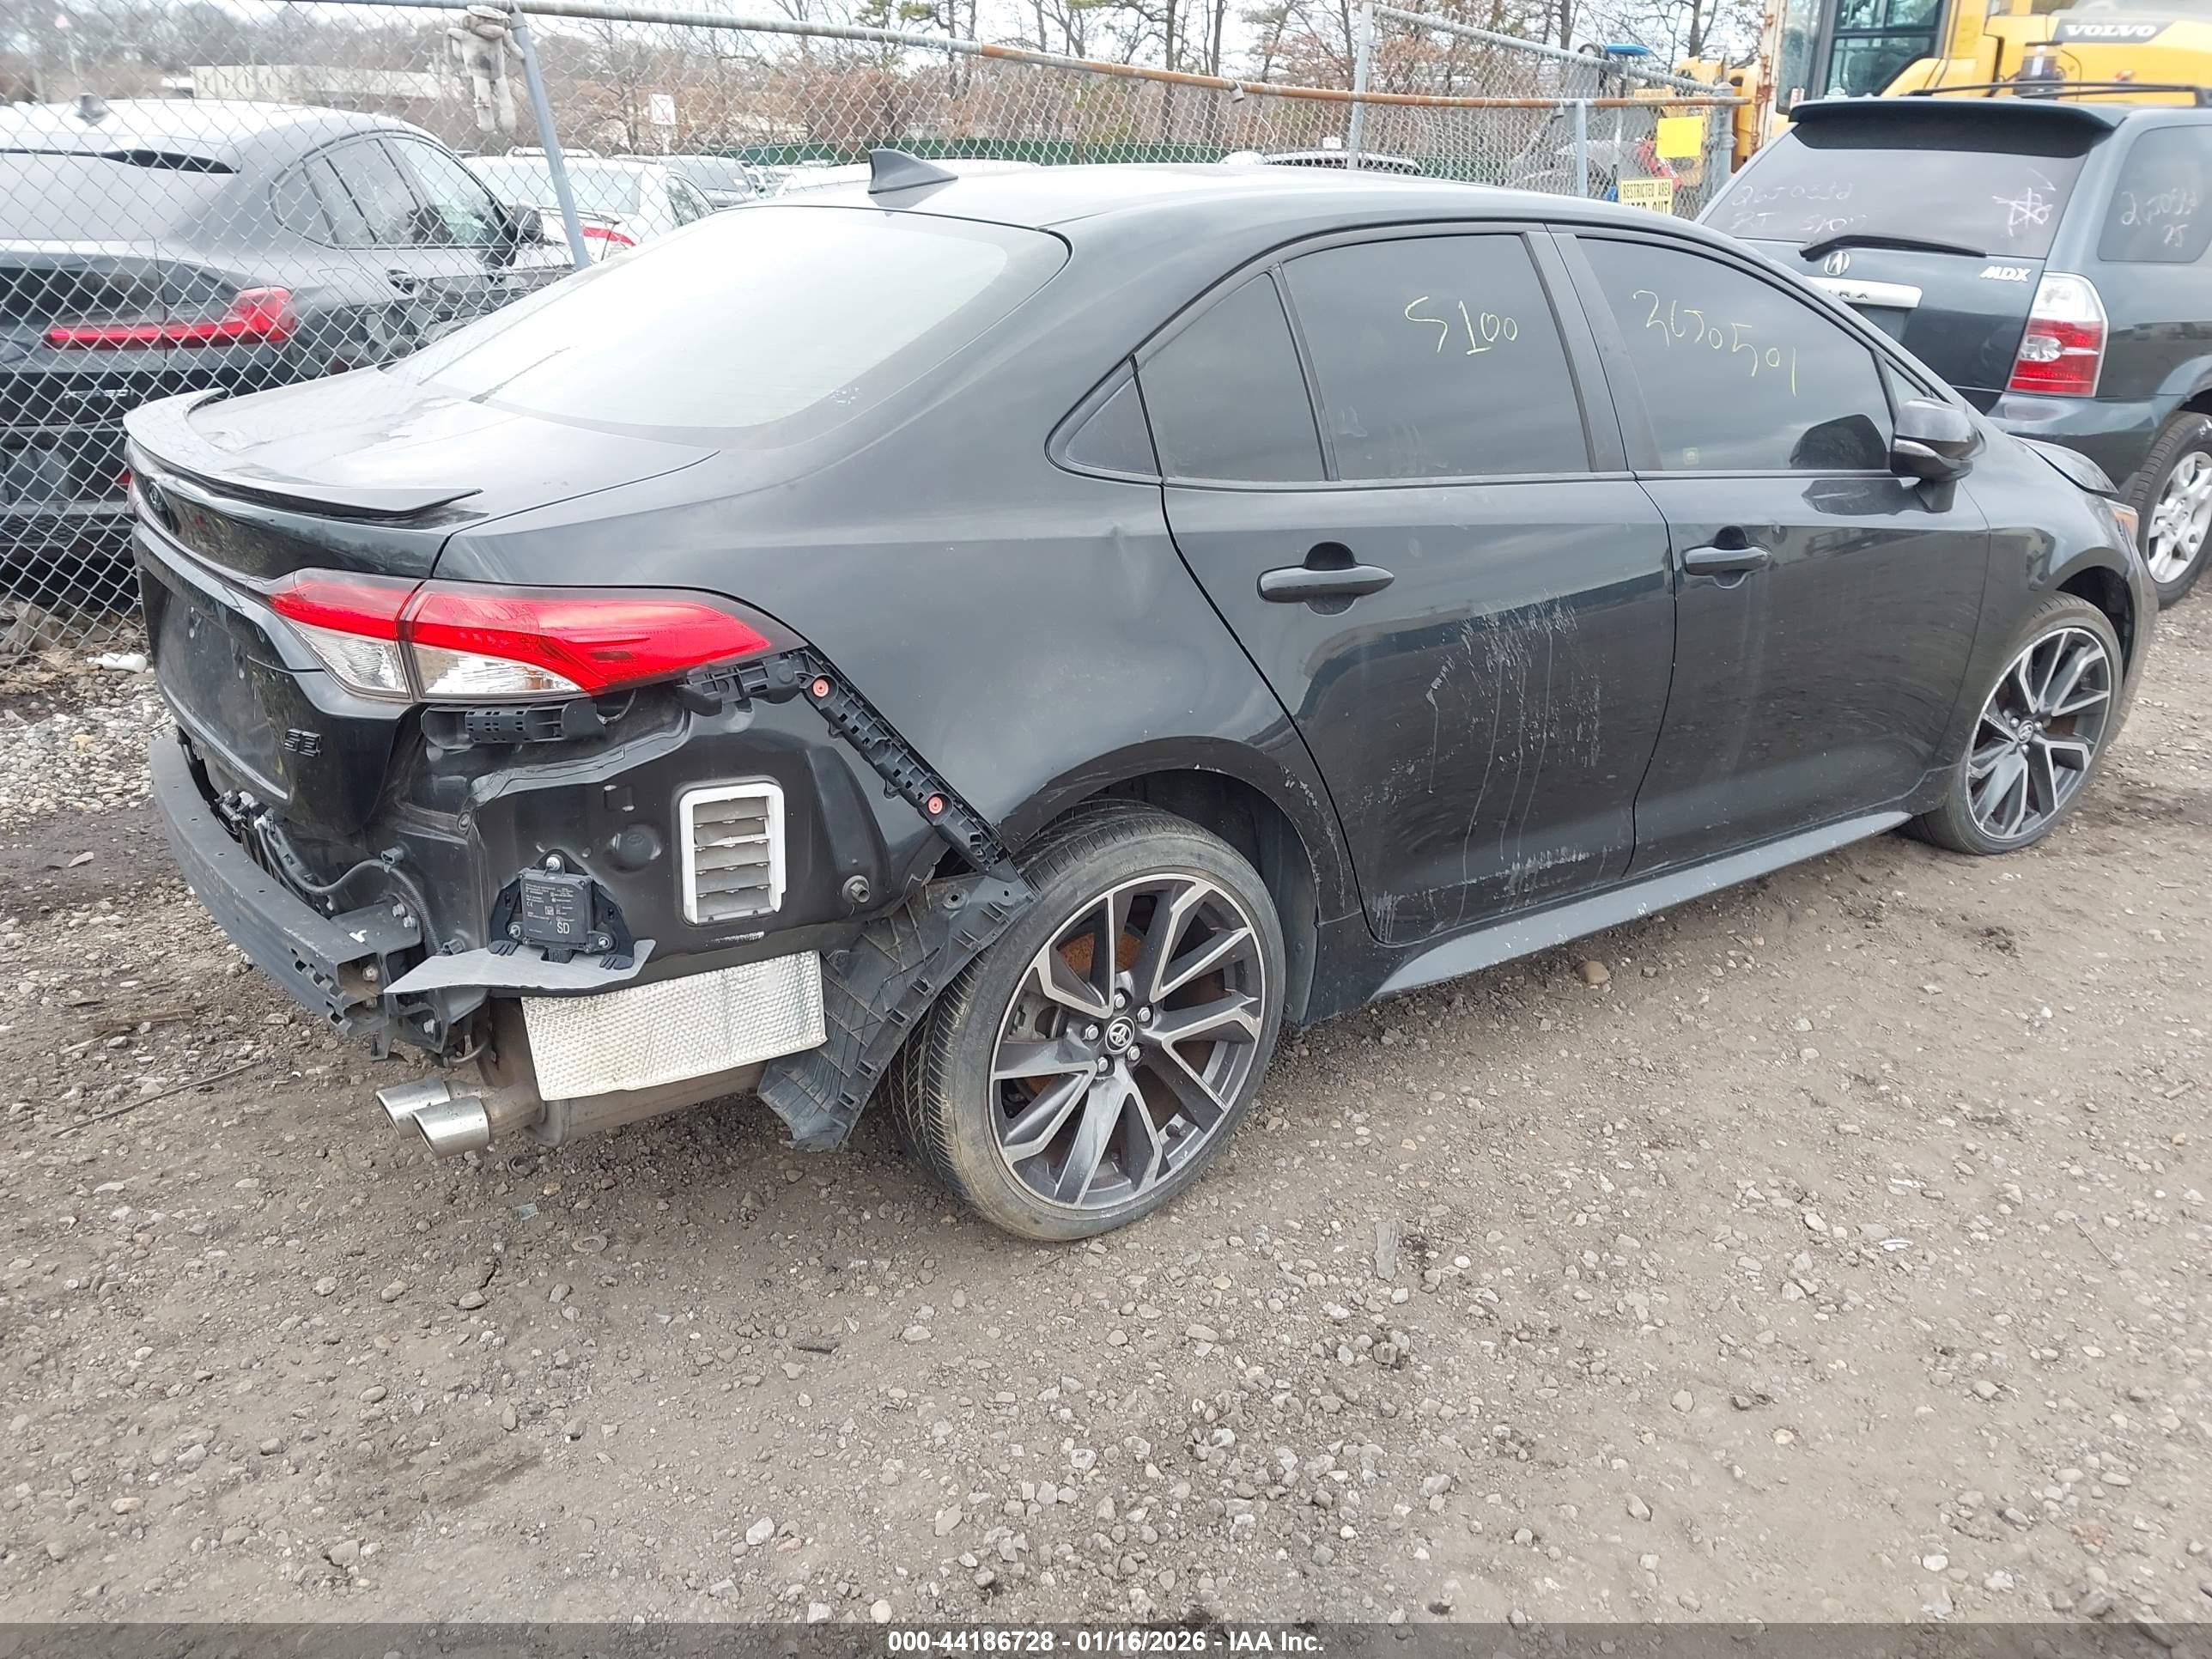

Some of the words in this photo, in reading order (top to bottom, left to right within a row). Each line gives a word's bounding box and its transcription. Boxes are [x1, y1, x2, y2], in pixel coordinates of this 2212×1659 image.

[2064, 24, 2158, 37] VOLVO
[1622, 183, 1656, 199] RESTRICTED
[1657, 181, 1671, 198] AREA
[1979, 265, 2032, 282] MDX
[283, 727, 321, 757] SE
[556, 921, 570, 934] SD
